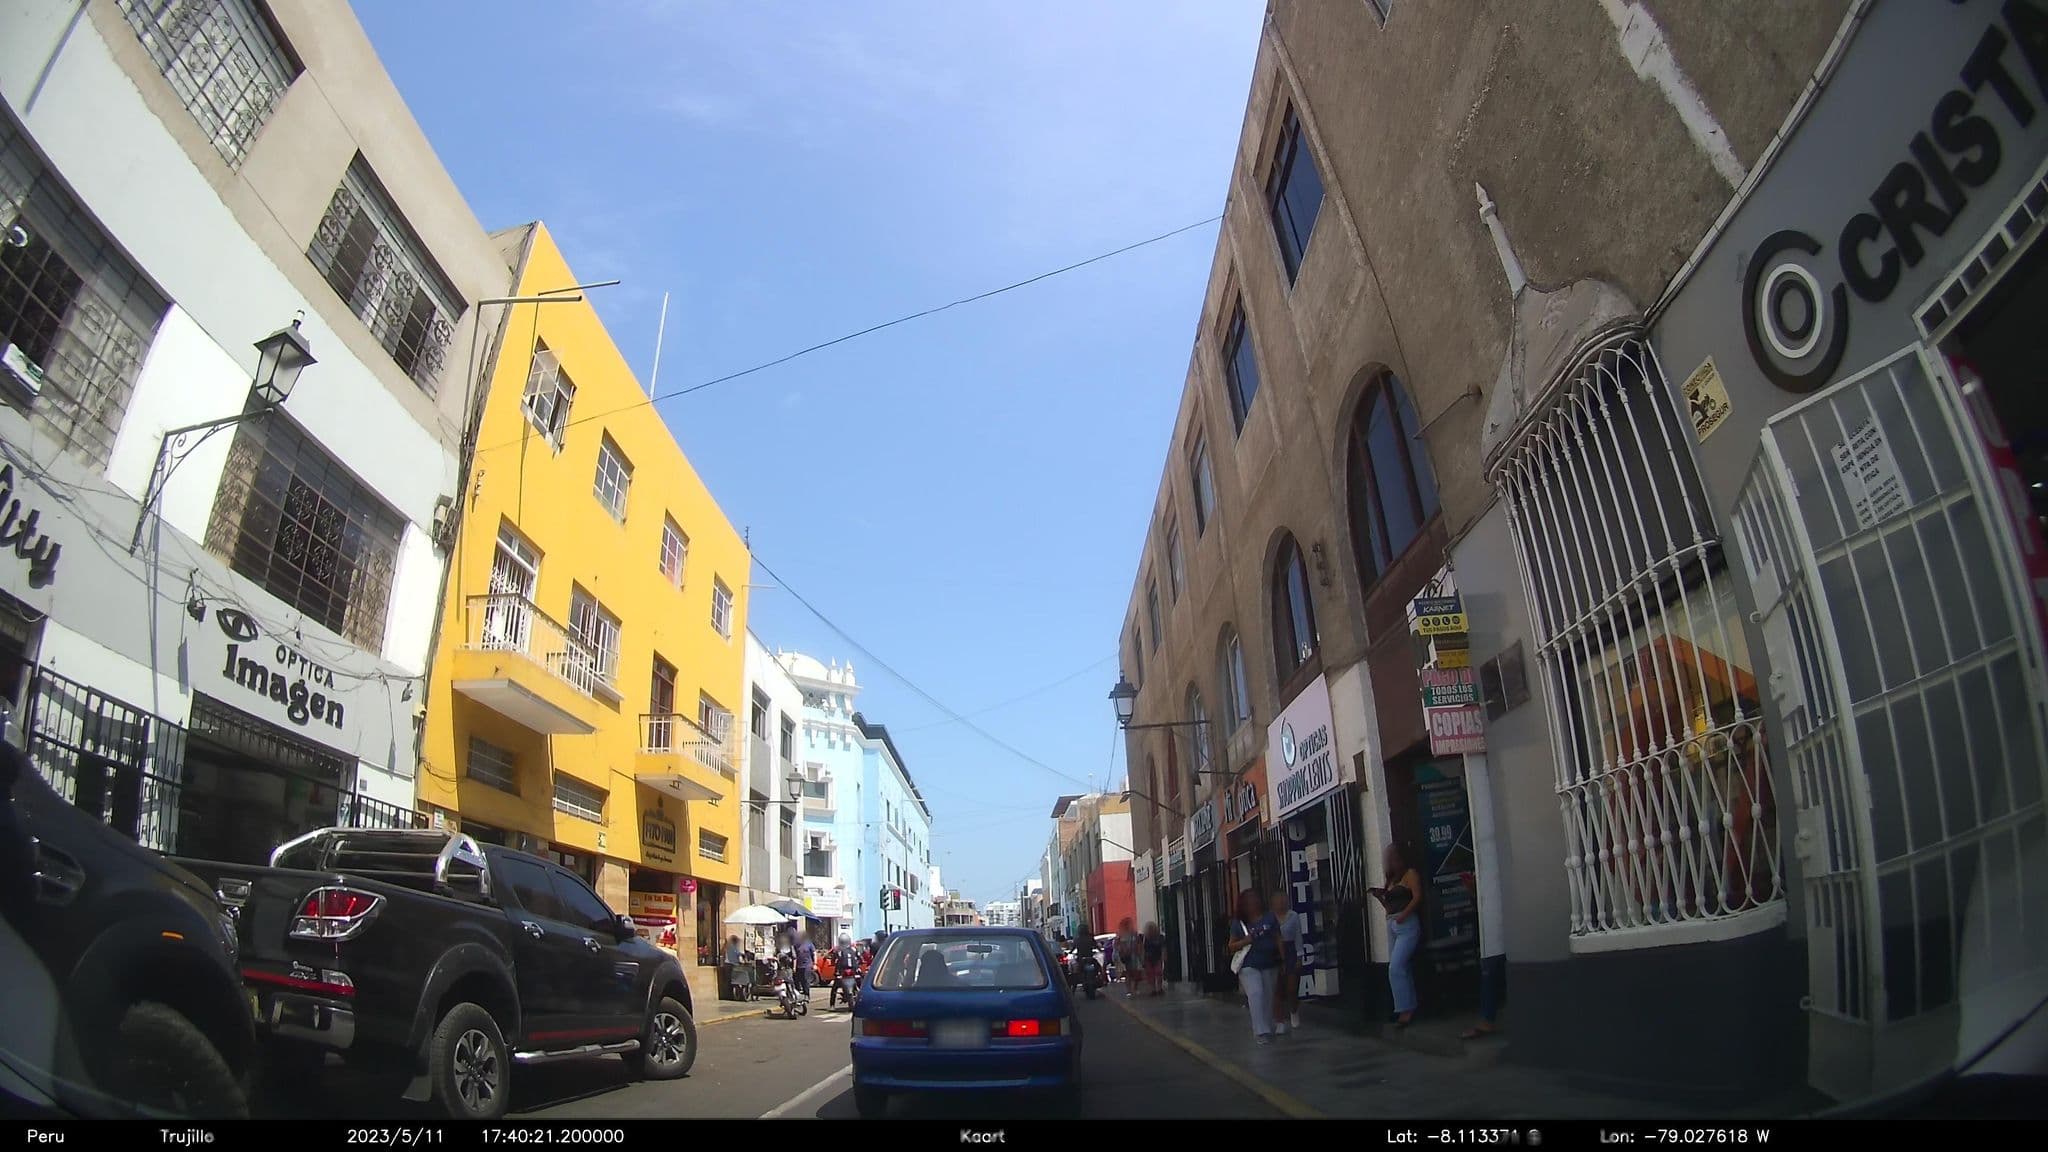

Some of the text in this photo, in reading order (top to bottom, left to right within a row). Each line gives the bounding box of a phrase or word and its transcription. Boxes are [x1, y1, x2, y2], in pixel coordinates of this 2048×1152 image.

[1697, 402, 1729, 435] PROSEGUR
[222, 643, 344, 730] Imagen
[1431, 685, 1474, 696] TODOS LOS
[1431, 694, 1475, 705] SERVICIOS
[1431, 710, 1484, 737] COPIAS
[1299, 724, 1329, 762] OPTICAS
